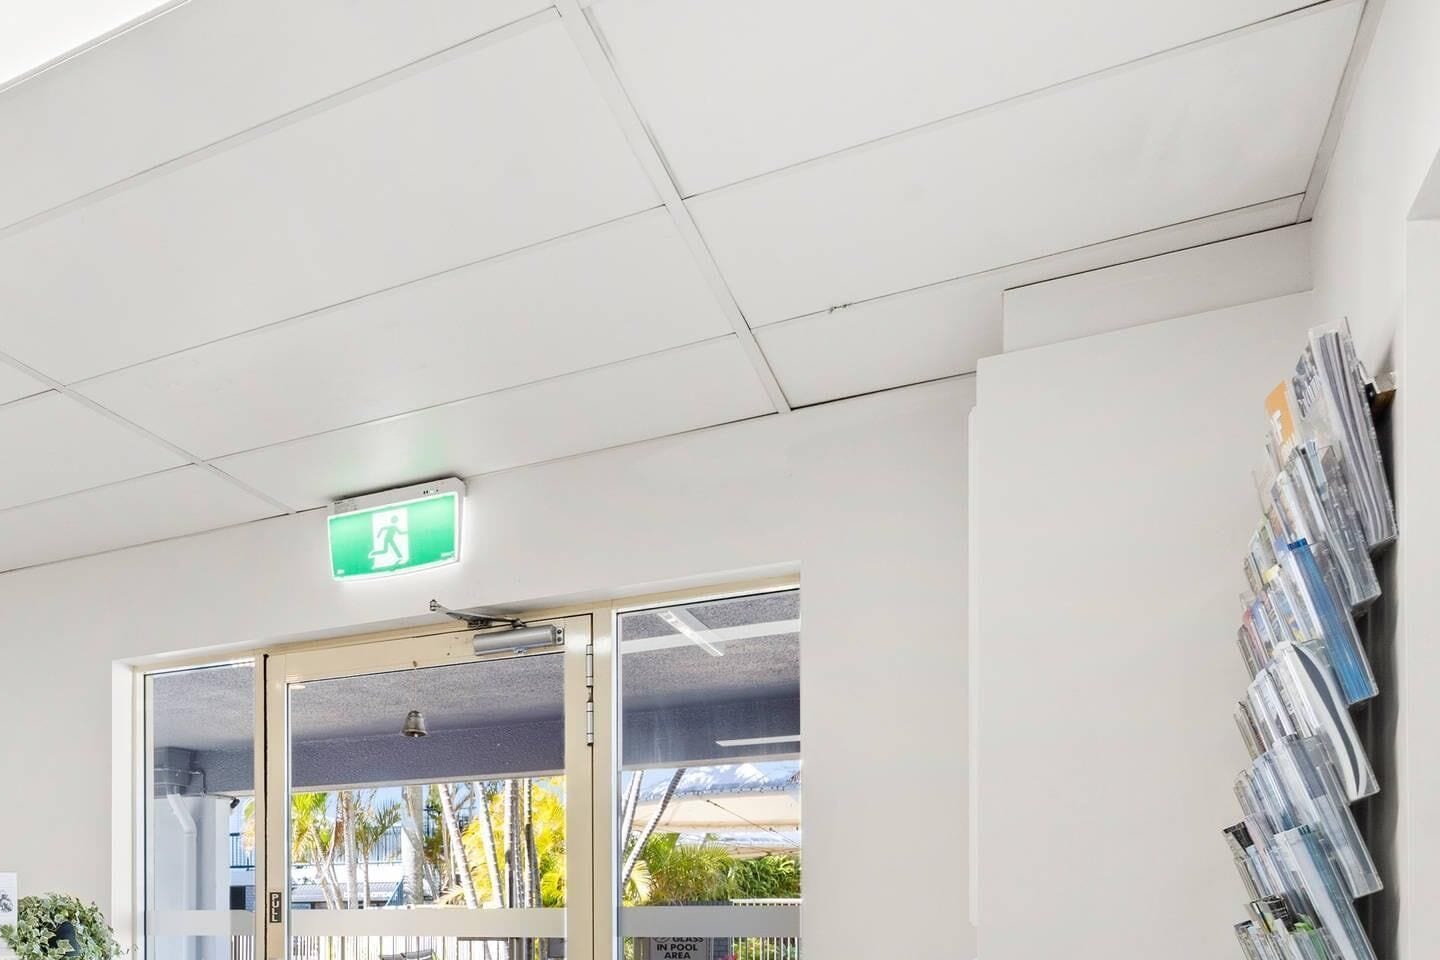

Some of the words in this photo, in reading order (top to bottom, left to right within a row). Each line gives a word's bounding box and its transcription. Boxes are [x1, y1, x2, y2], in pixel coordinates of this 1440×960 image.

[271, 893, 280, 922] PULL
[670, 943, 698, 951] POOL
[664, 951, 691, 959] AREA
